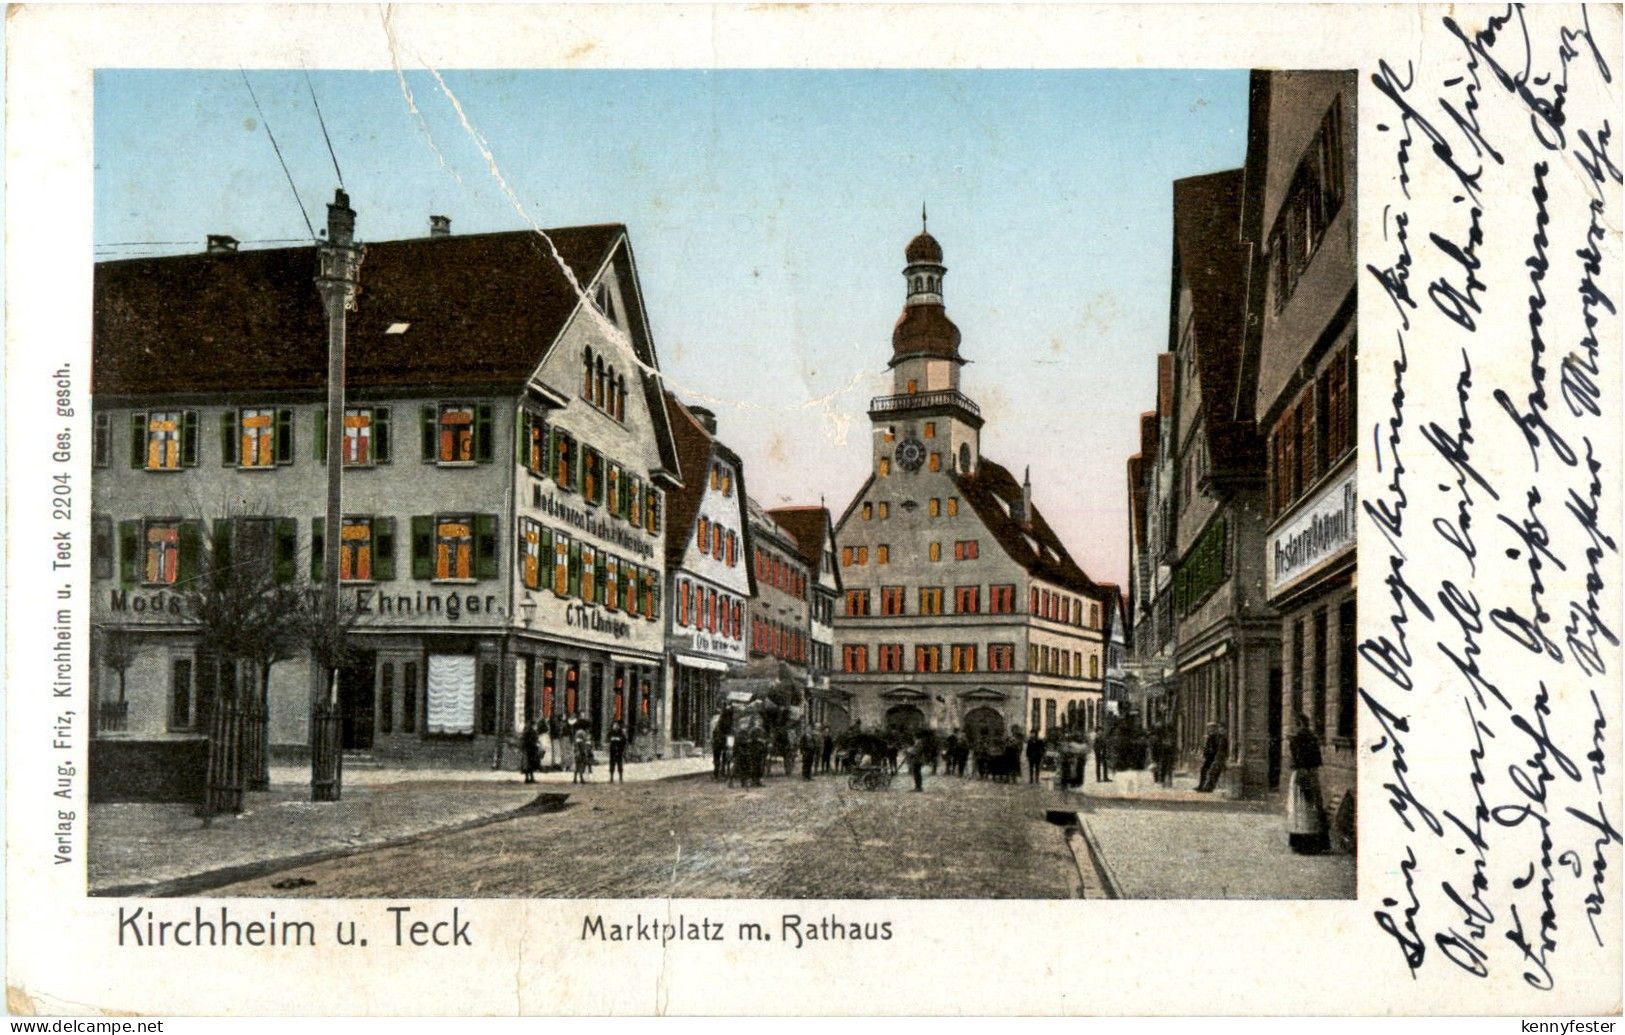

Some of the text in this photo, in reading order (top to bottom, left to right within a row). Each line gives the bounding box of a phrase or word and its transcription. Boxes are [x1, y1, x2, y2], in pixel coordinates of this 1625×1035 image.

[53, 364, 75, 864] Verlag Aug. Friz, Kirchheim u. Teck 2204 Ges. gesch.
[119, 907, 471, 946] Kirchheim u. Teck
[582, 915, 892, 948] Marktplatz m. Rathaus
